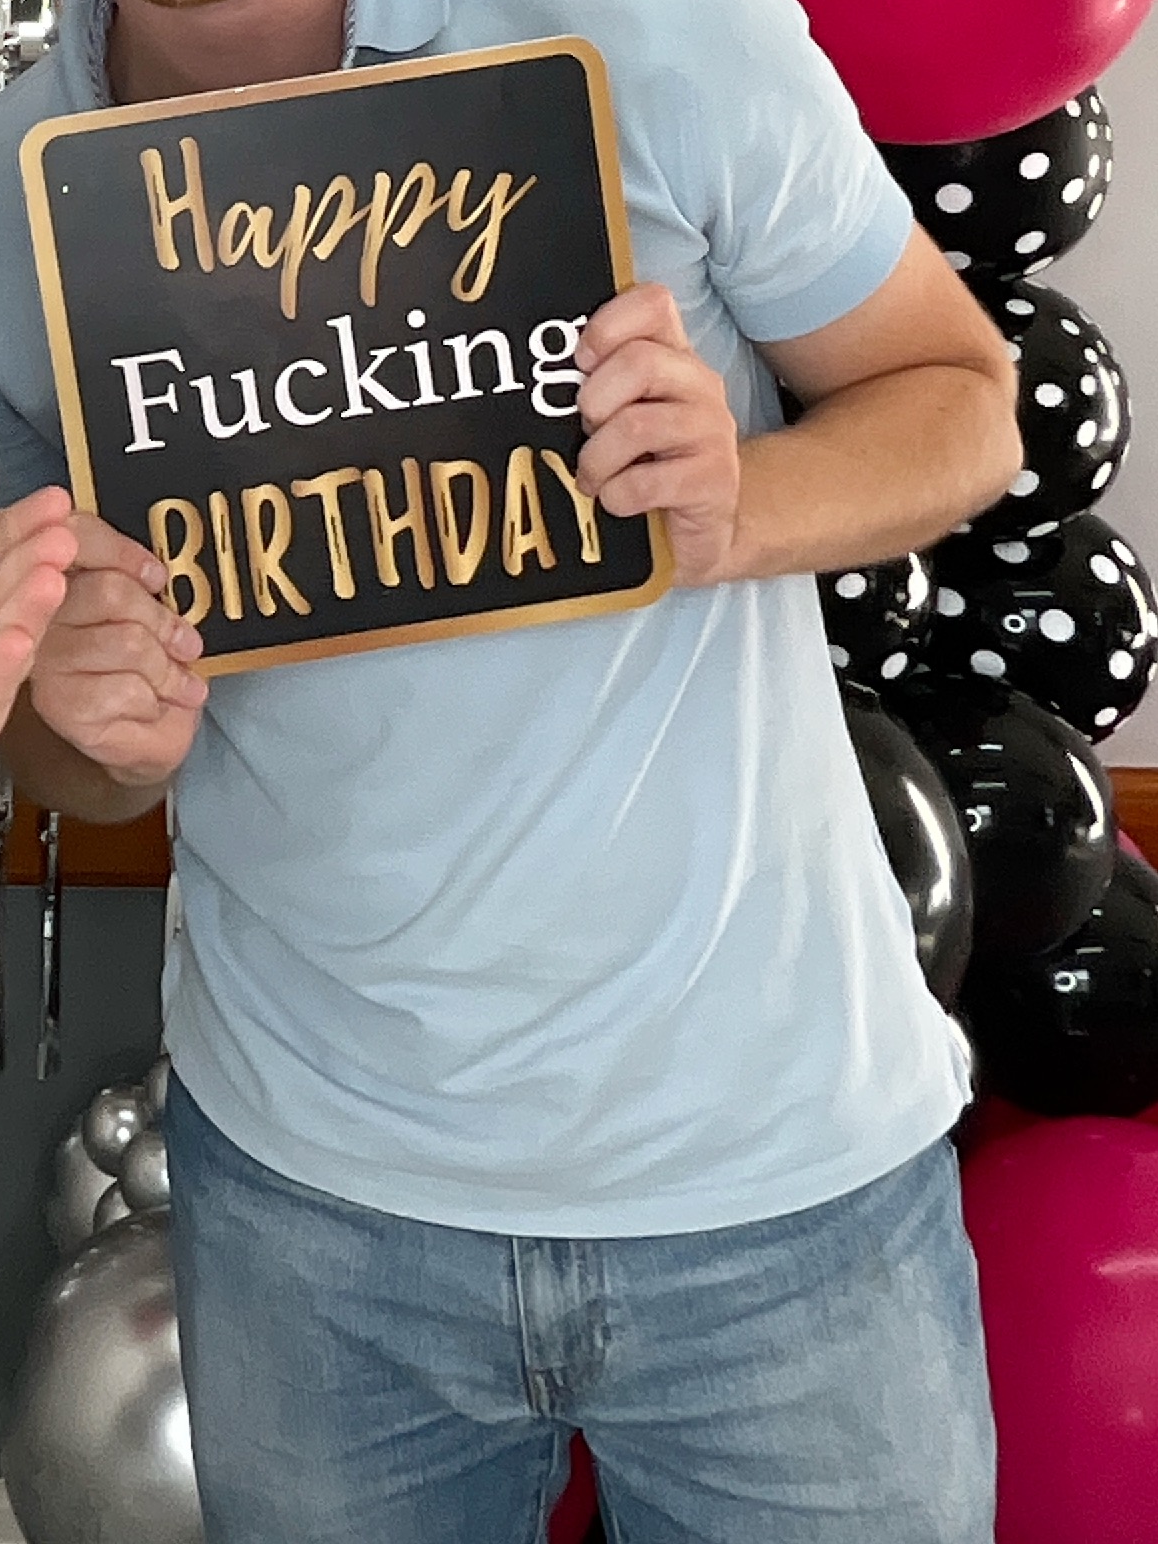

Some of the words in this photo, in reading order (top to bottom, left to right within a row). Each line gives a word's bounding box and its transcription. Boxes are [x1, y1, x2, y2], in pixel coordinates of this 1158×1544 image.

[140, 136, 537, 319] Happy
[110, 308, 590, 454] Fucking
[147, 446, 602, 626] BIRTHDAY
